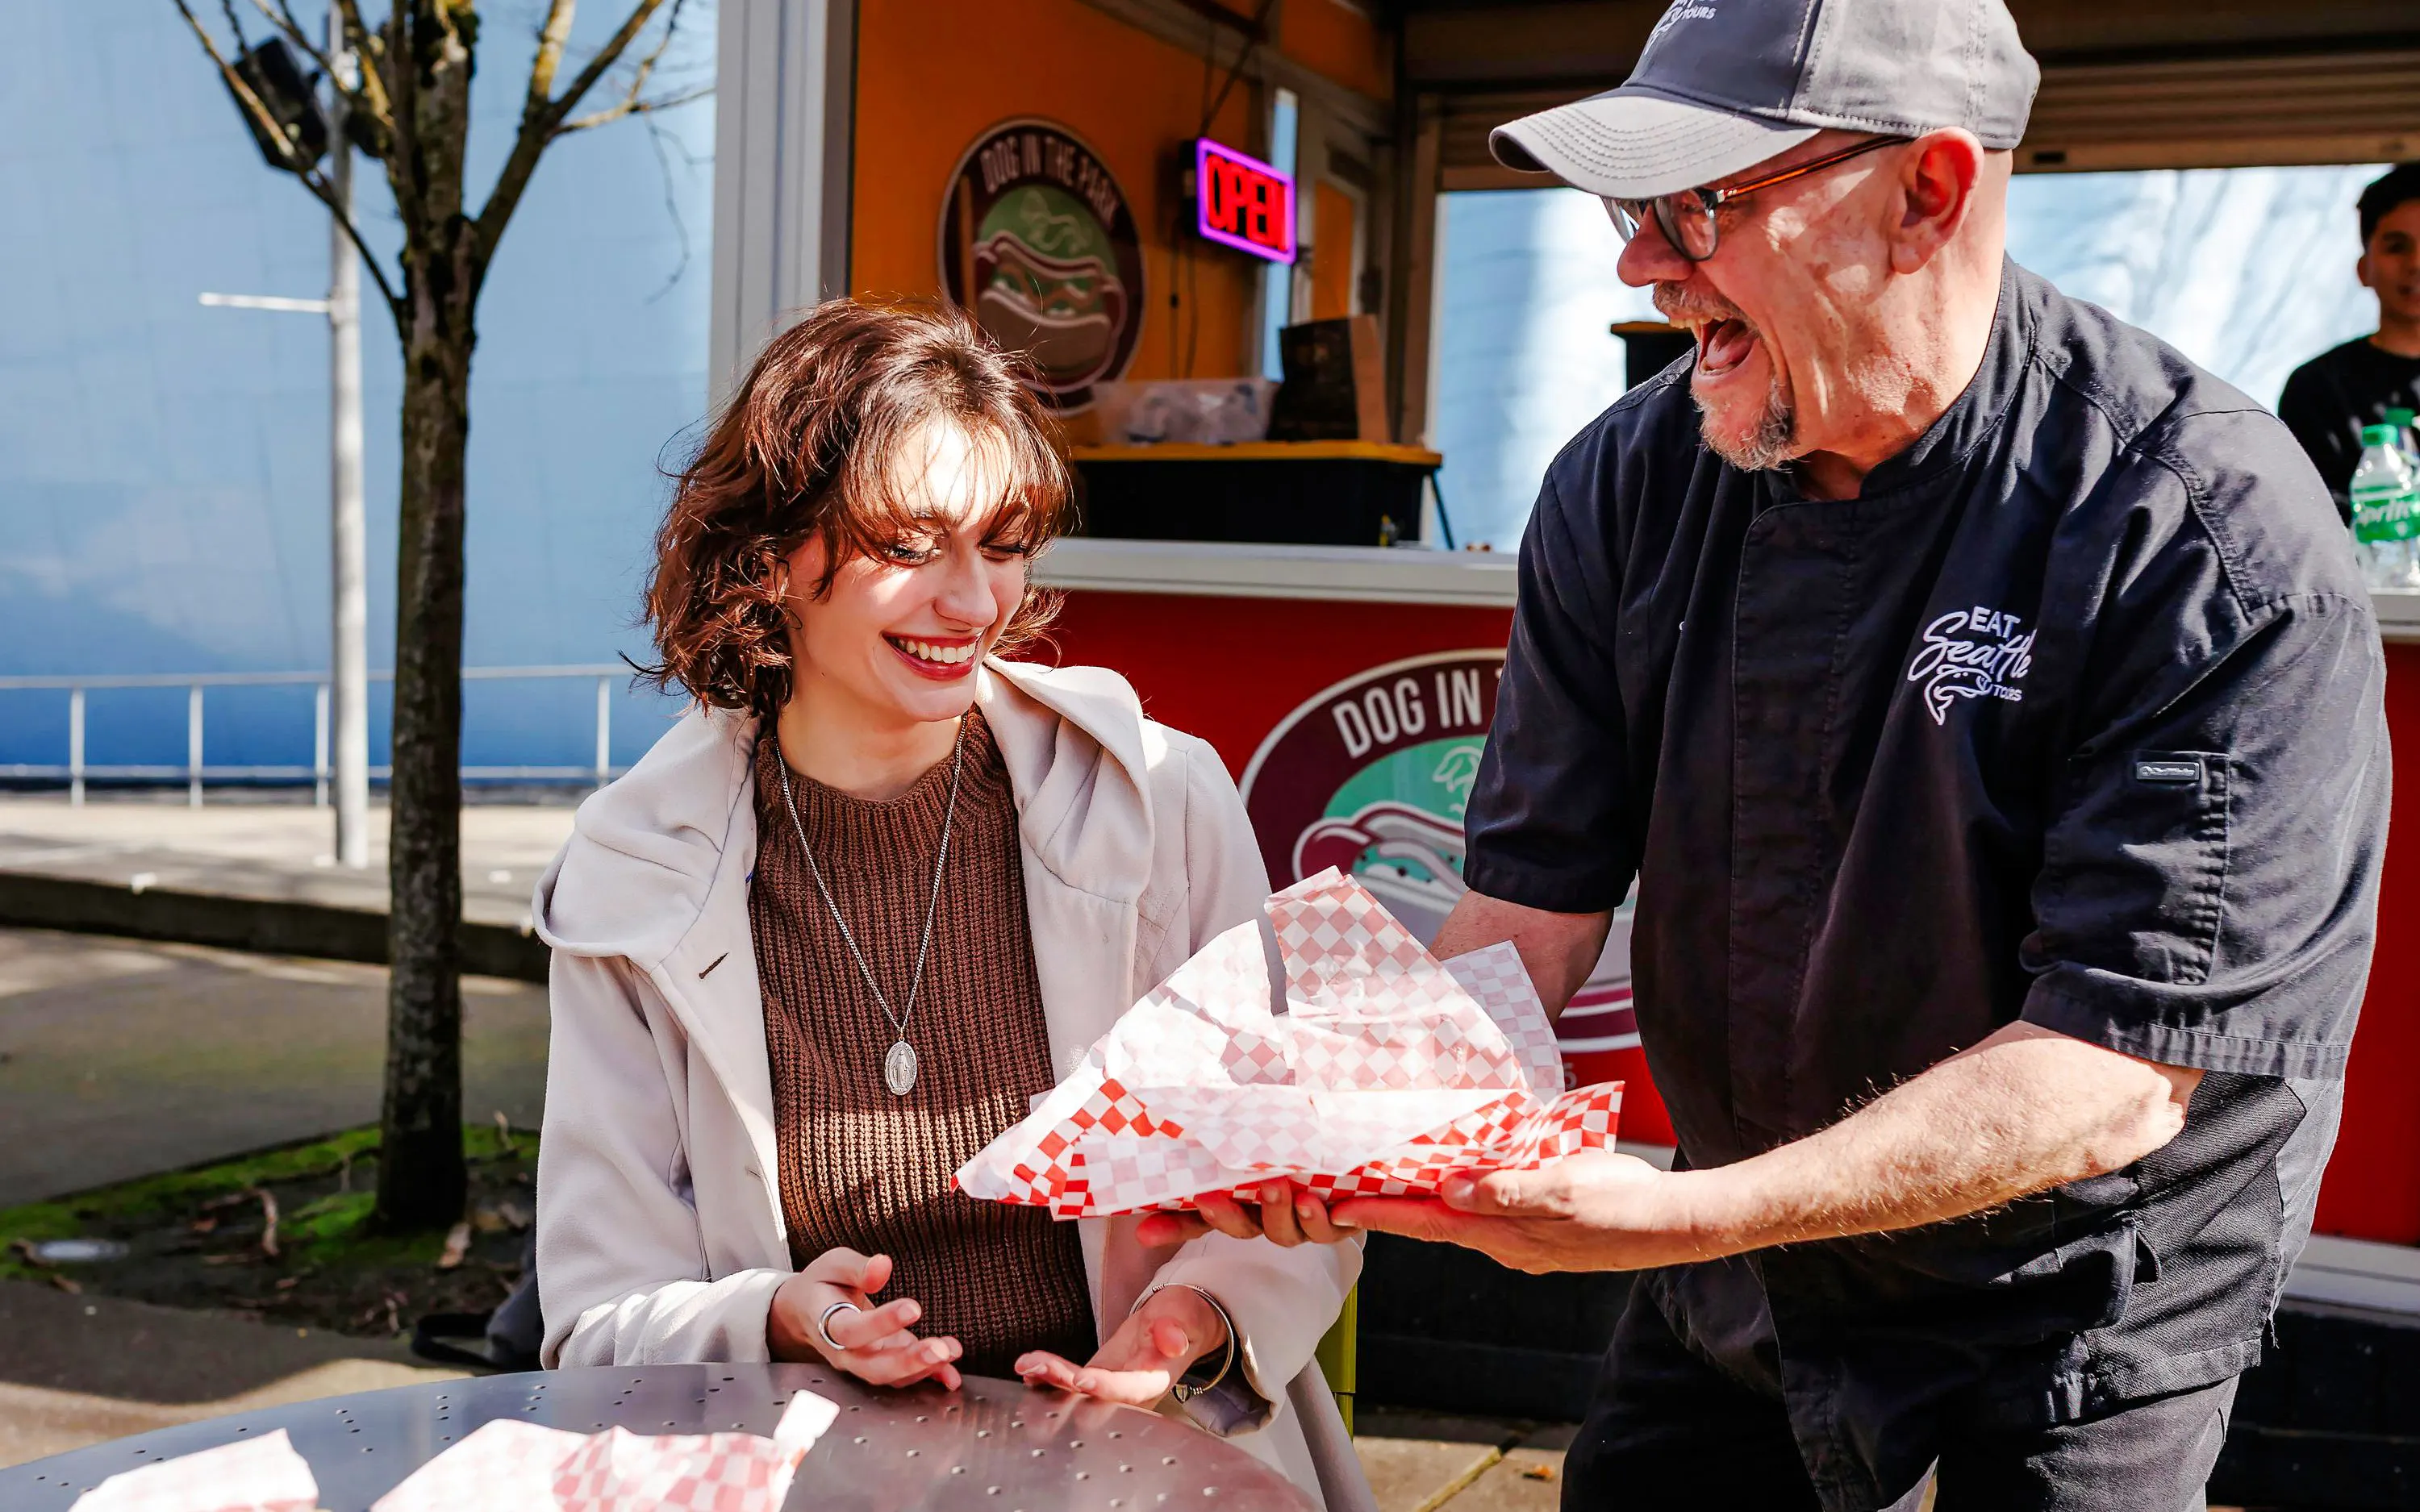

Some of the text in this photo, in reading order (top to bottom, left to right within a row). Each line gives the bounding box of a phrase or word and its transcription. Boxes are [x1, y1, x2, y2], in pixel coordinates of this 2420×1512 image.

[979, 134, 1121, 234] DOG IN THE PARK
[1205, 154, 1288, 252] OPEN
[1968, 606, 2022, 639] EAT
[1331, 667, 1483, 759] DOG IN
